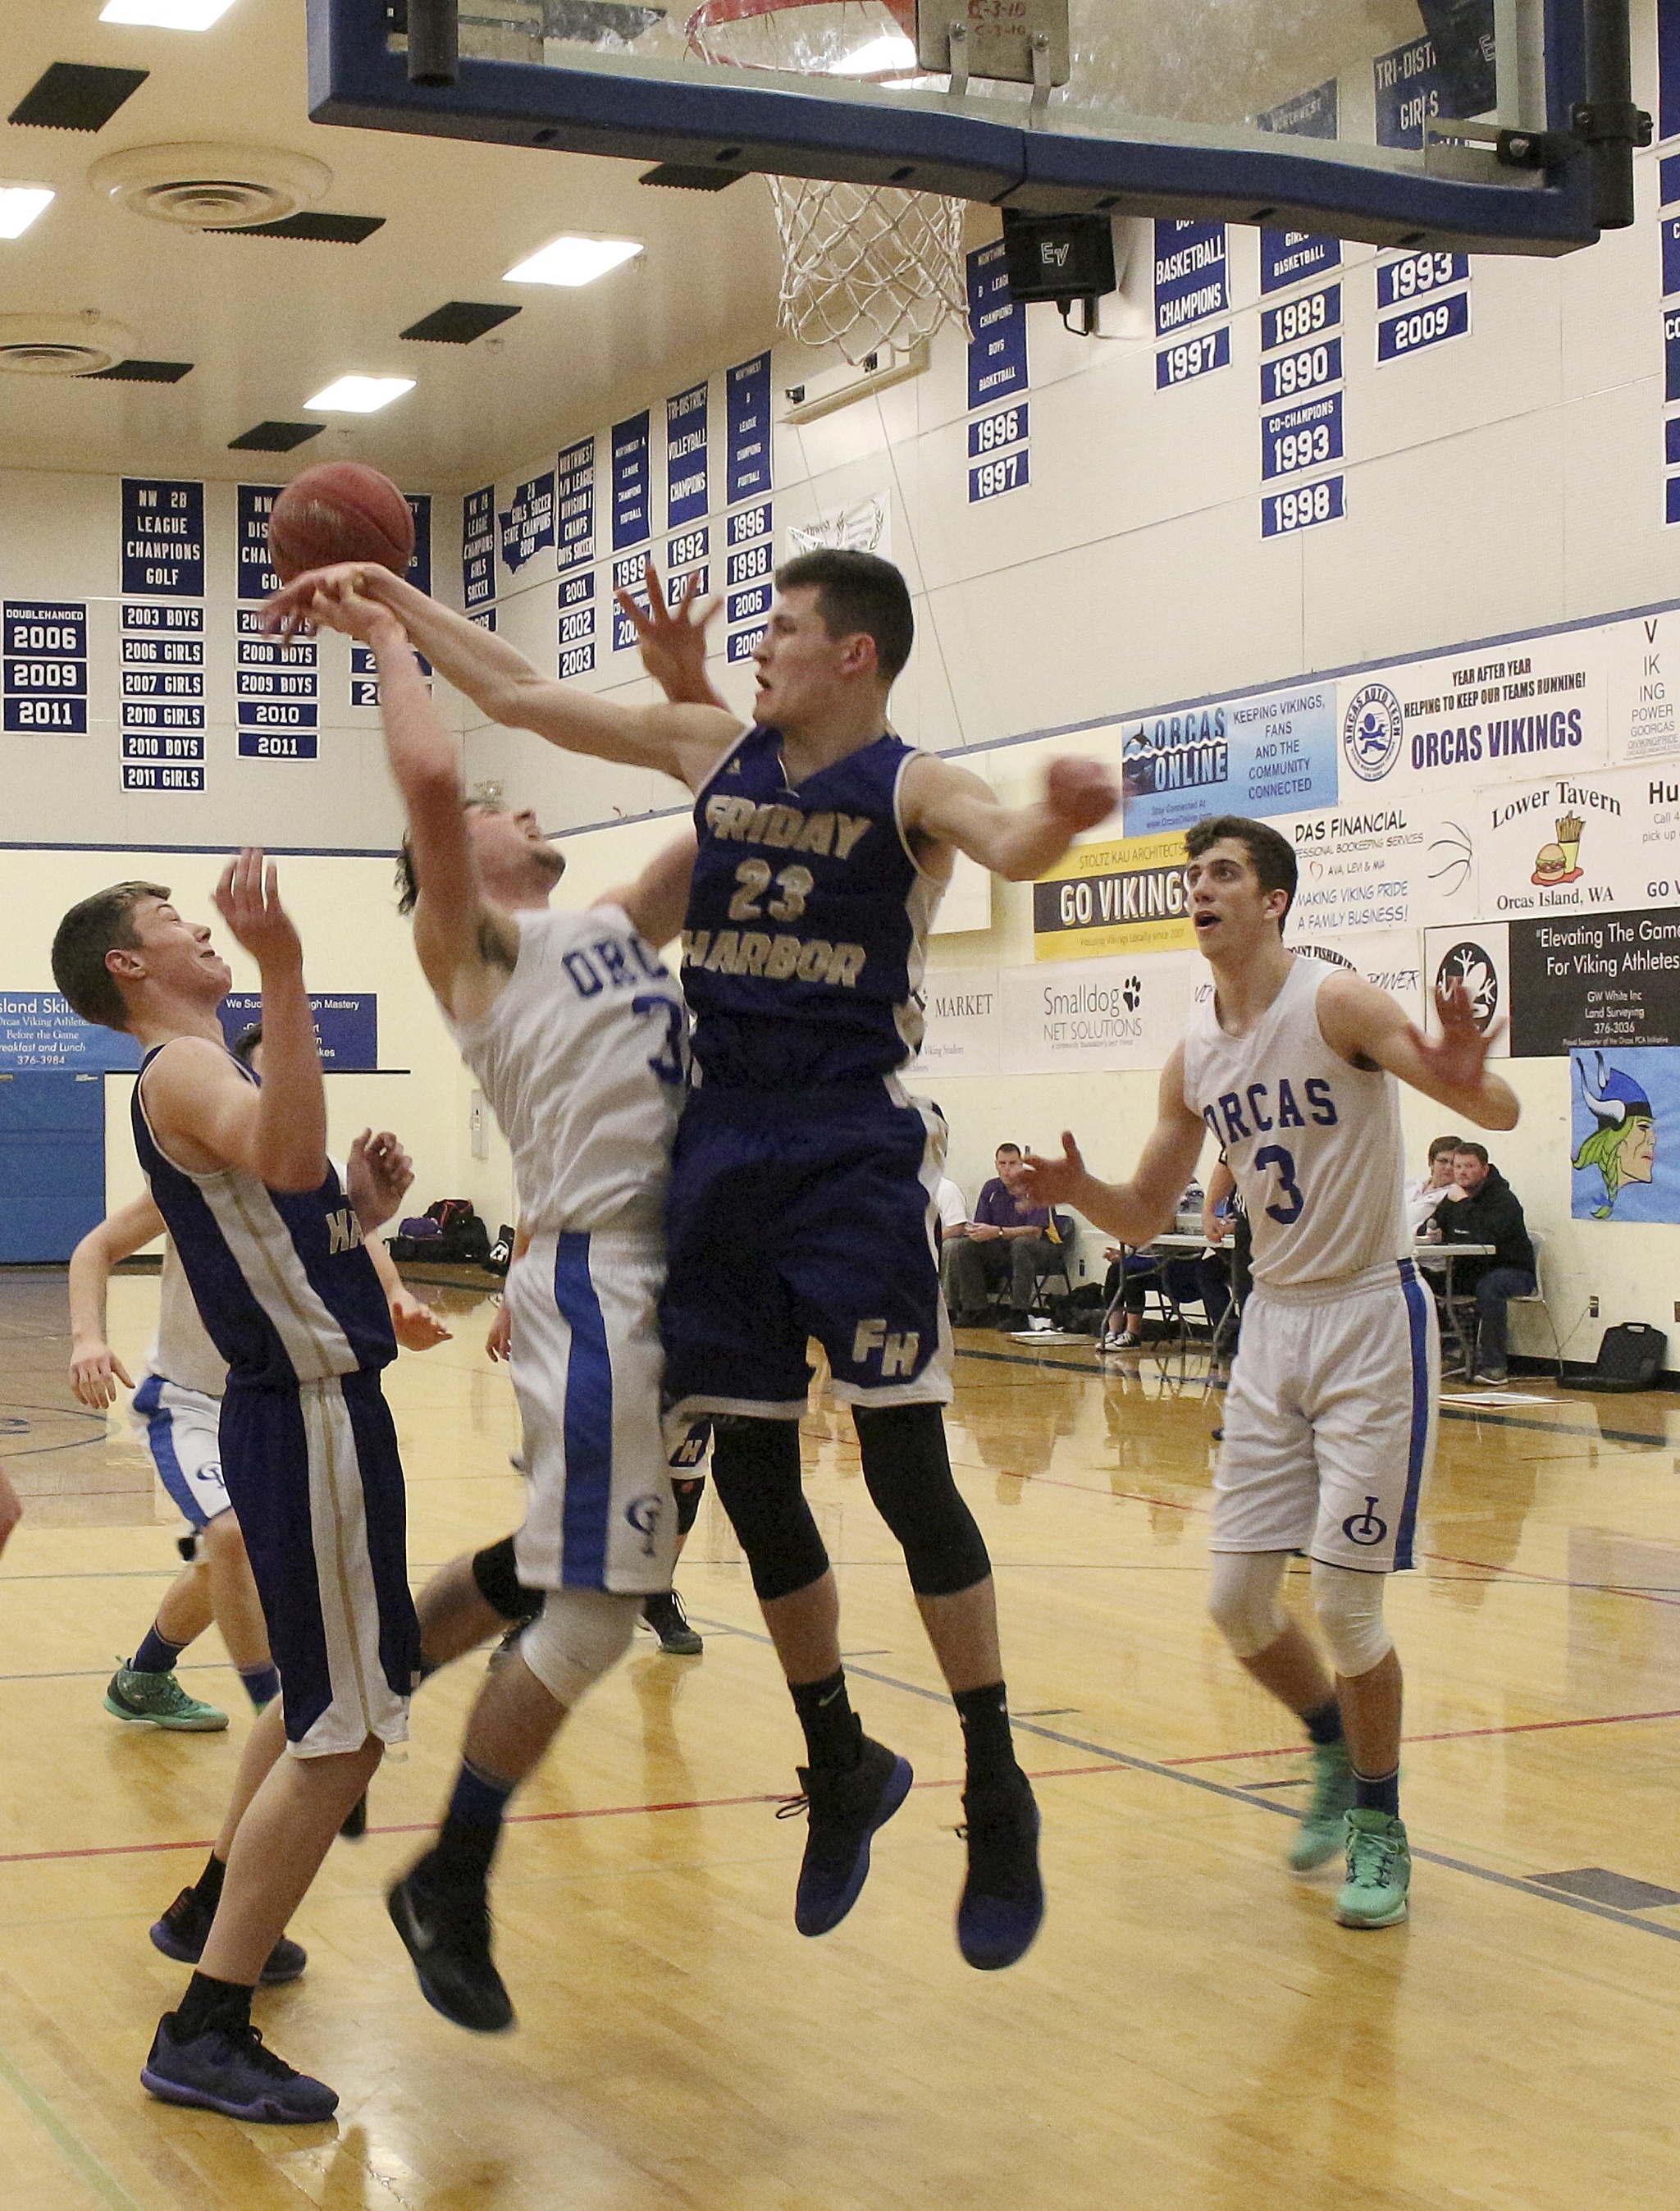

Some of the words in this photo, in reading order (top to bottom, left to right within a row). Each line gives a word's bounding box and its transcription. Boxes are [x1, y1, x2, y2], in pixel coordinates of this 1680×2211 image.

[1156, 235, 1226, 284] BASKETBALL
[1273, 244, 1325, 276] BASKETBALL
[1392, 254, 1452, 300] 1993
[1159, 283, 1221, 329] CHAMPIONS
[1275, 294, 1326, 344] 1989
[1395, 306, 1449, 349] 2009
[1166, 334, 1217, 383] 1997
[1273, 345, 1328, 396] 1990
[979, 366, 1016, 392] BASKETBALL
[1269, 400, 1334, 433] CO-CHAMPIONS
[669, 427, 706, 461] VOLLEYBALL
[978, 411, 1019, 452] 1996
[1274, 424, 1329, 473] 1993
[670, 472, 705, 503] CHAMPIONS
[978, 457, 1018, 498] 1997
[139, 490, 158, 507] NW
[1274, 483, 1330, 532] 1998
[137, 515, 188, 534] LEAGUE
[504, 524, 518, 546] STATE
[564, 516, 588, 541] CHAMPS
[733, 507, 765, 541] 1996
[126, 541, 201, 561] CHAMPIONS
[672, 532, 704, 565] 1992
[146, 568, 180, 586] GOLF
[617, 555, 646, 587] 1999
[733, 547, 765, 582] 1998
[468, 579, 489, 601] SOCCER
[565, 578, 587, 603] 2001
[6, 609, 84, 621] DOUBLEHANDED
[735, 590, 763, 618] 2006
[127, 608, 160, 625] 2003
[166, 609, 199, 627] BOYS
[562, 611, 591, 642] 2002
[13, 625, 77, 649] 2006
[1644, 619, 1658, 644] V
[126, 642, 158, 660] 2006
[164, 644, 201, 661] GIRLS
[281, 645, 313, 664] BOYS
[562, 646, 591, 677] 2003
[13, 664, 78, 688] 2009
[1452, 669, 1475, 688] YEAR
[1477, 663, 1505, 683] AFTER
[1507, 658, 1532, 678] YEAR
[1644, 654, 1660, 676] IK
[126, 674, 157, 692] 2007
[164, 675, 201, 694] GIRLS
[241, 675, 274, 693] 2009
[281, 676, 313, 694] BOYS
[1404, 698, 1440, 718] HELPING
[1443, 695, 1454, 711] TO
[1457, 691, 1478, 709] KEEP
[1481, 687, 1500, 705] OUR
[1501, 680, 1535, 701] TEAMS
[1537, 671, 1586, 696] RUNNING!
[1640, 683, 1665, 702] ING
[19, 701, 72, 725] 2011
[126, 706, 157, 724] 2010
[163, 706, 200, 725] GIRLS
[256, 706, 300, 724] 2010
[1233, 704, 1277, 724] KEEPING
[1281, 695, 1325, 717] VIKINGS,
[1365, 688, 1388, 703] AUTO
[1388, 700, 1400, 736] TECH
[1632, 704, 1673, 723] POWER
[1155, 707, 1226, 750] ORCAS
[1265, 721, 1292, 738] FANS
[1412, 724, 1482, 770] ORCAS
[1487, 709, 1582, 758] VIKINGS
[129, 738, 158, 756] 2010
[166, 738, 199, 756] BOYS
[258, 738, 298, 756] 2011
[1255, 743, 1277, 759] AND
[1281, 739, 1299, 755] THE
[128, 768, 156, 787] 2011
[162, 769, 199, 788] GIRLS
[1154, 745, 1228, 792] ONLINE
[1249, 758, 1311, 779] COMMUNITY
[1249, 779, 1312, 799] CONNECTED
[1491, 789, 1550, 831] Lower
[1556, 781, 1622, 816] Tavern
[705, 793, 873, 860] FRIDAY
[1295, 821, 1326, 843] DAS
[1331, 810, 1408, 838] FINANCIAL
[1642, 832, 1660, 843] pick
[1664, 831, 1676, 842] up
[1386, 833, 1424, 847] SERVICES
[1080, 852, 1110, 869] STOLTZ
[1112, 848, 1130, 864] KAU
[728, 857, 815, 923] 23
[1295, 889, 1337, 907] MAKING
[1341, 884, 1375, 902] VIKING
[1377, 880, 1408, 898] PRIDE
[1497, 894, 1534, 911] Orcas
[1539, 888, 1583, 907] Island,
[1588, 885, 1614, 902] WA
[1647, 881, 1669, 898] GO
[1060, 882, 1093, 926] GO
[1297, 916, 1305, 930] A
[1308, 911, 1344, 930] FAMILY
[1348, 904, 1408, 925] BUSINESS!
[1607, 921, 1634, 943] The
[681, 930, 866, 989] HARBOR
[1547, 957, 1570, 975] For
[1573, 953, 1617, 977] Viking
[226, 999, 242, 1008] We
[324, 999, 359, 1011] Mastery
[935, 994, 993, 1017] MARKET
[1044, 984, 1120, 1017] Smalldog
[1587, 991, 1603, 1003] GW
[1605, 989, 1628, 1002] White
[1630, 989, 1642, 1000] Inc
[23, 1016, 52, 1027] Viking
[1585, 1007, 1605, 1018] Land
[1606, 1006, 1645, 1020] Surveying
[7, 1030, 34, 1039] Before
[37, 1030, 51, 1039] the
[52, 1030, 79, 1039] Game
[1043, 1021, 1067, 1041] NET
[1071, 1018, 1143, 1040] SOLUTIONS
[39, 1043, 57, 1052] and
[59, 1042, 85, 1052] Lunch
[17, 1055, 65, 1065] 376-3984
[1255, 1144, 1304, 1224] 3
[852, 1318, 920, 1377] FH
